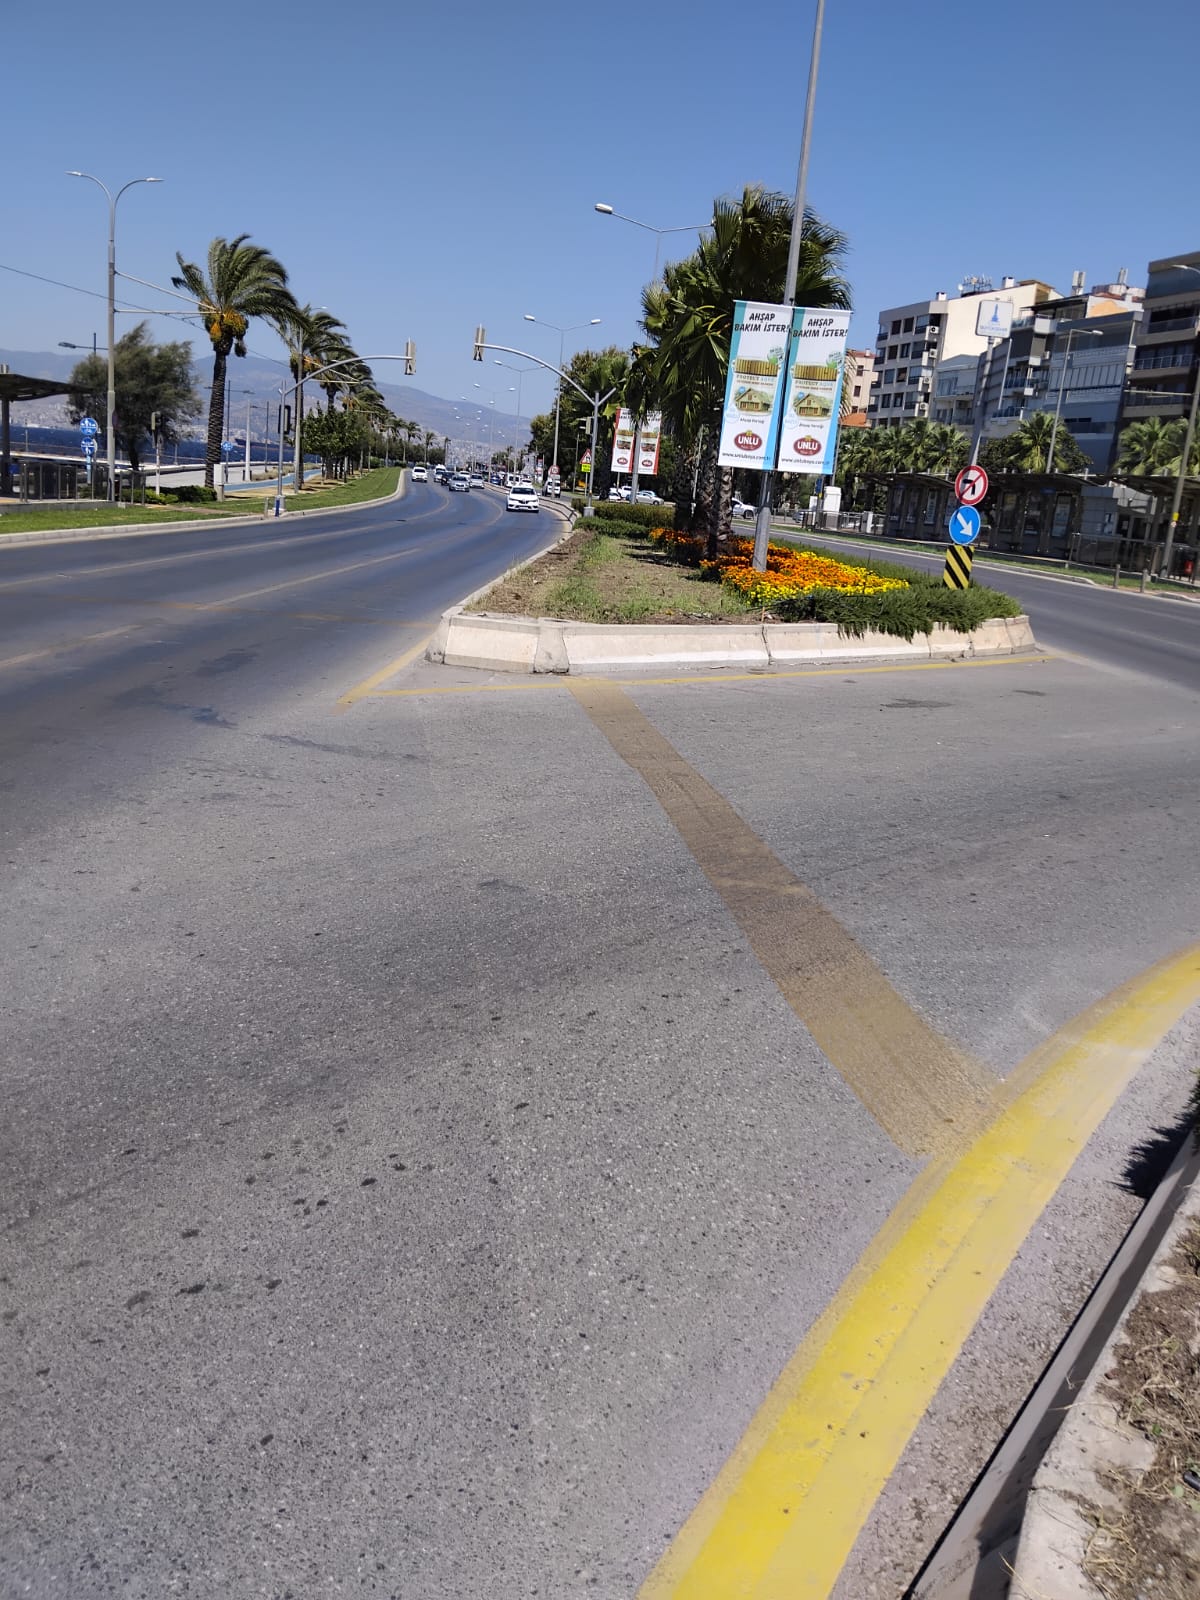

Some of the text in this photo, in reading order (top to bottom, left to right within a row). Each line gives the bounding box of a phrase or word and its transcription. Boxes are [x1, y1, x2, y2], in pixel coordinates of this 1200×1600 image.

[749, 313, 775, 323] AHŞAP
[807, 318, 834, 328] AHŞAP
[734, 322, 790, 333] BAKIM İSTER!
[792, 327, 848, 338] BAKIM İSTER!
